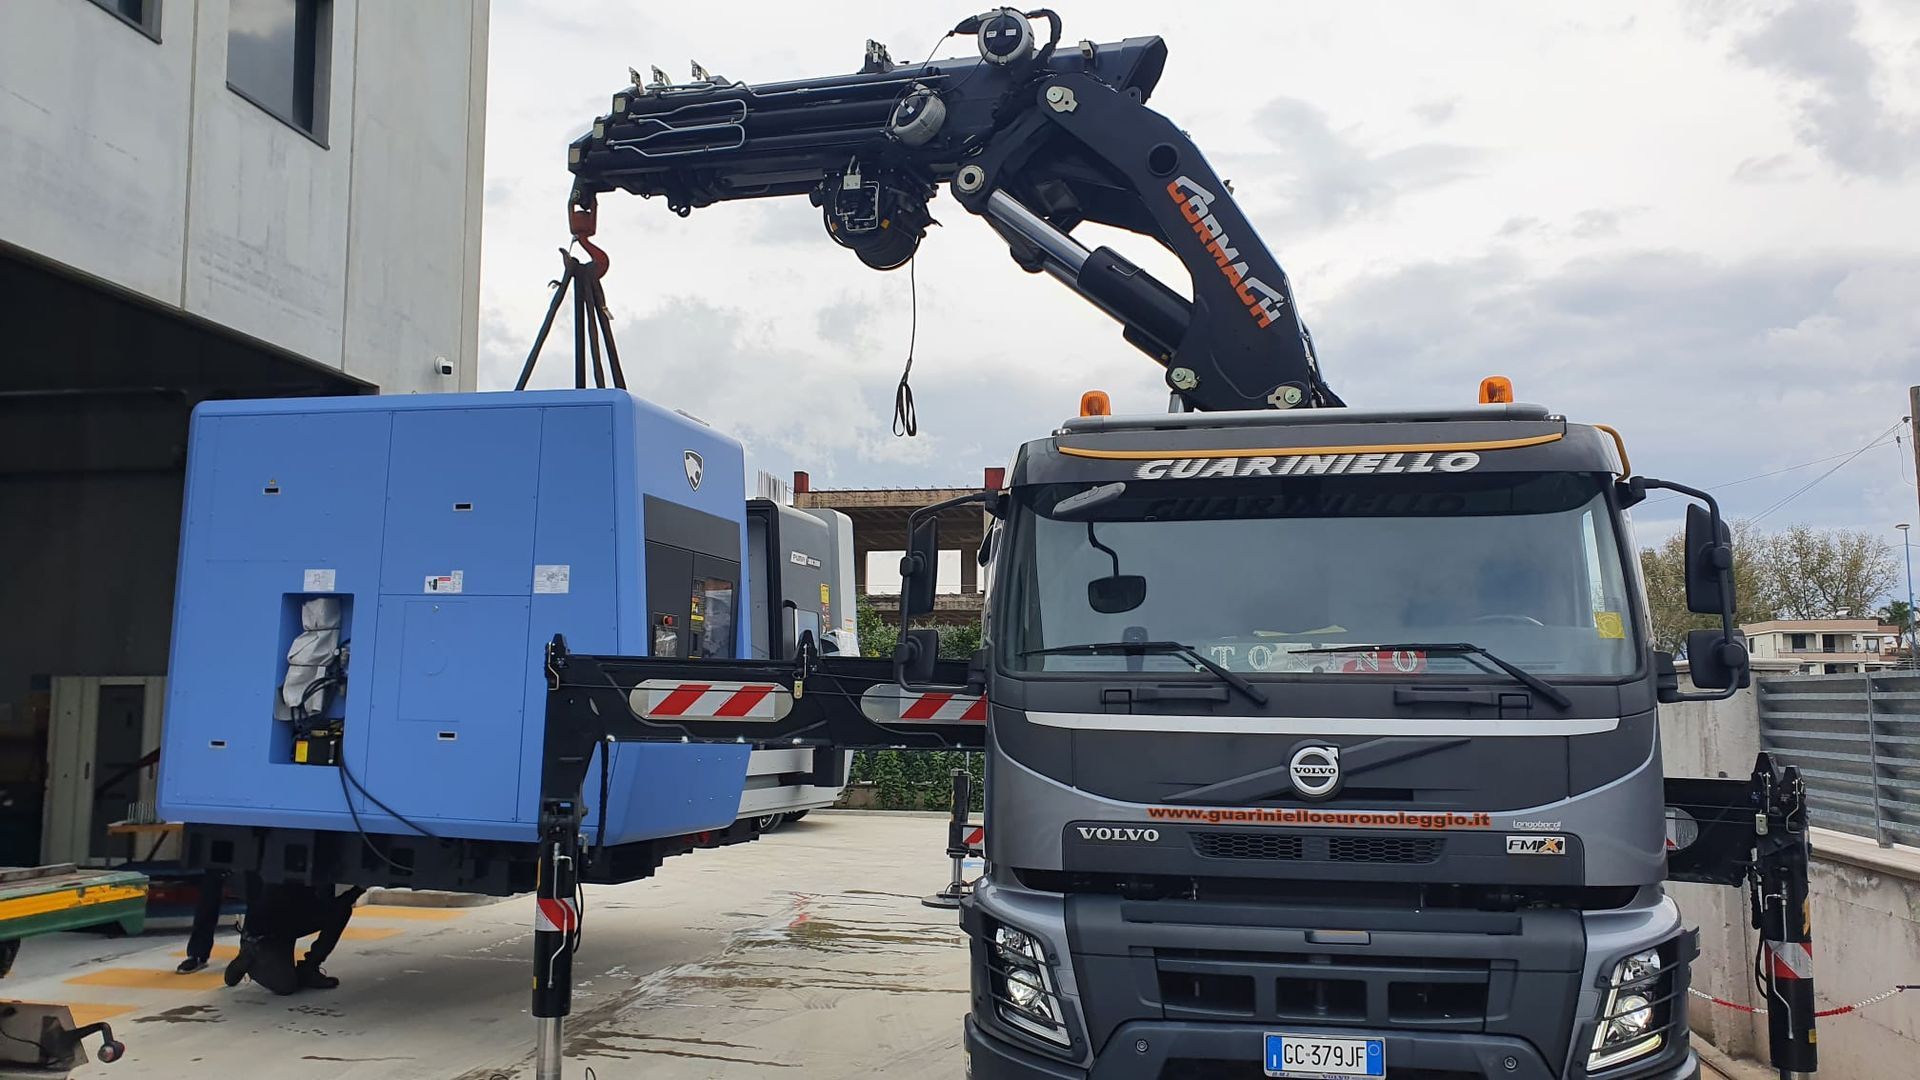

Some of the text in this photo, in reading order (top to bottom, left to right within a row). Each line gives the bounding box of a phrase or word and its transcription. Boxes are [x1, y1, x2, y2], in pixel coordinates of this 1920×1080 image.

[1167, 175, 1284, 328] CORMACH
[1135, 452, 1481, 479] GUARINIELLO
[1211, 646, 1418, 672] TONINO
[1147, 806, 1491, 828] www.guarinielloeuronoleggio.it
[1077, 827, 1159, 841] VOLVO
[1508, 838, 1561, 853] FMX
